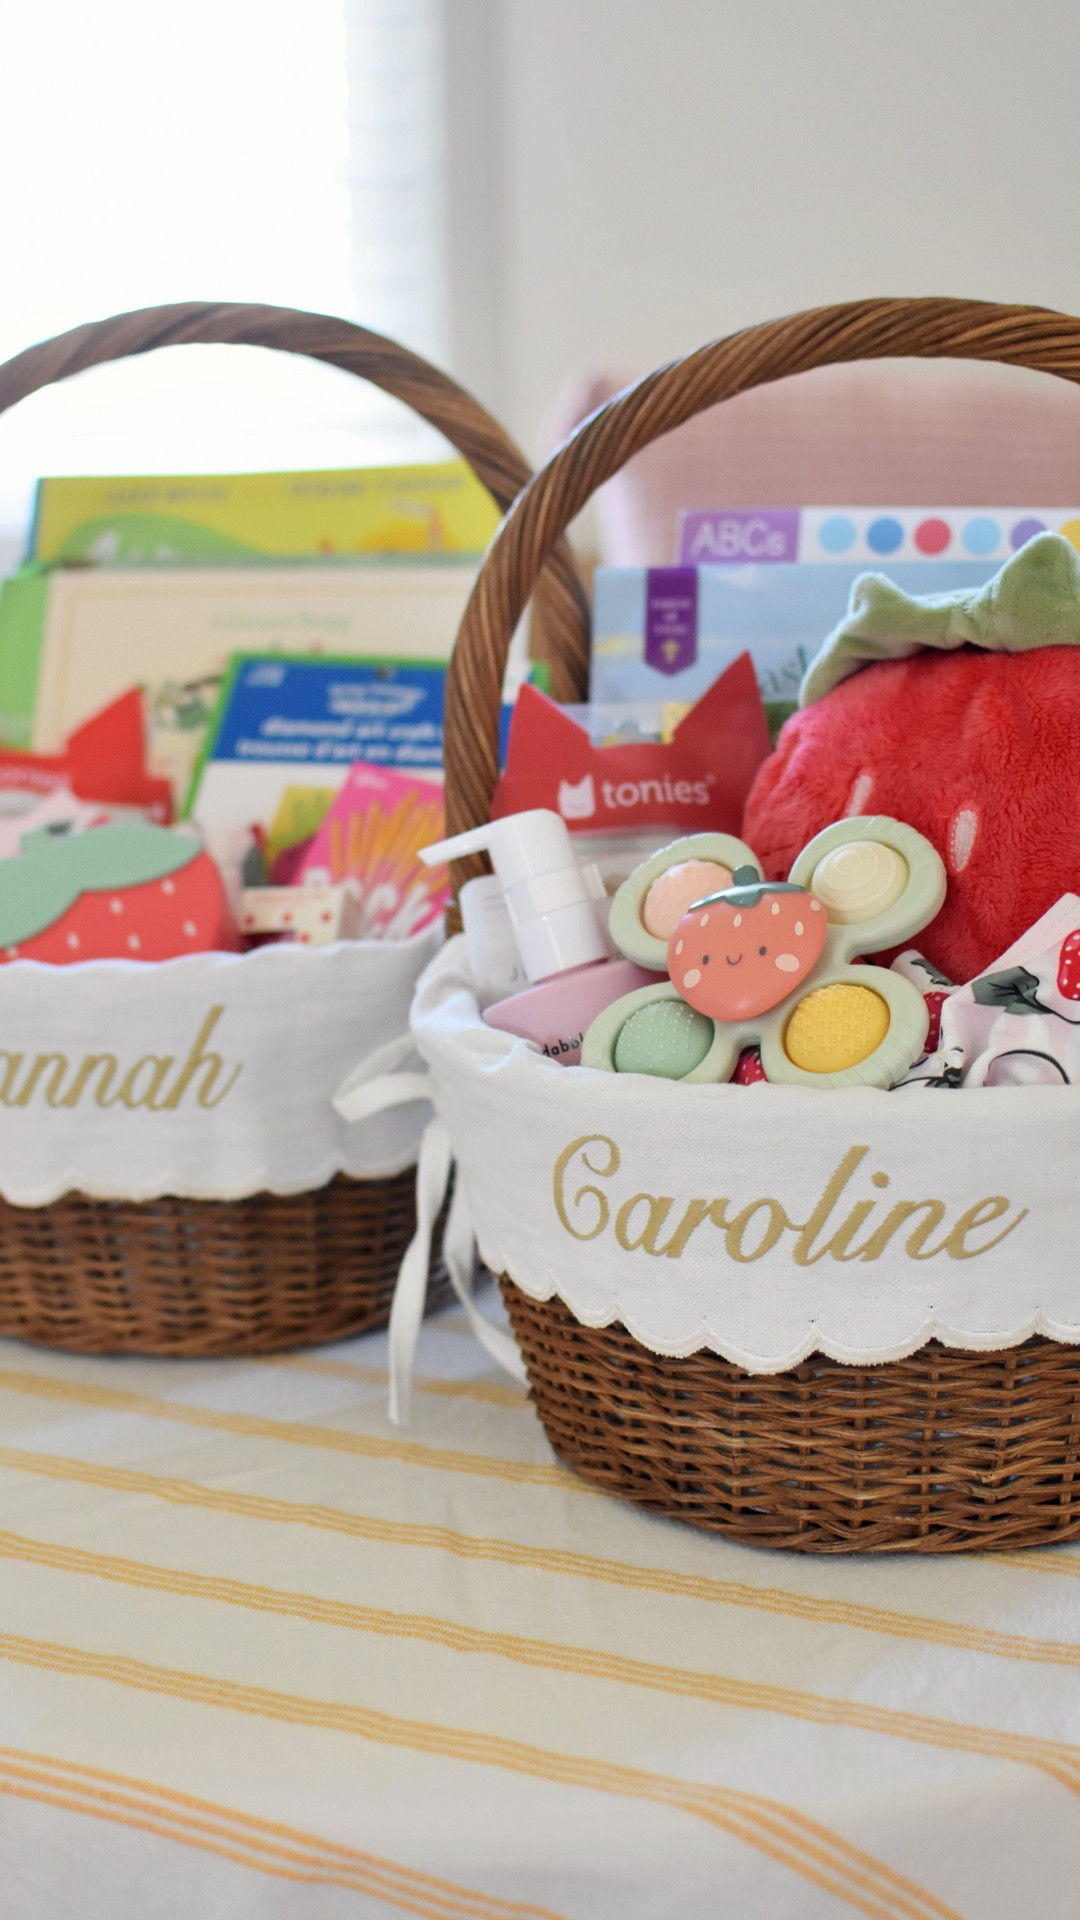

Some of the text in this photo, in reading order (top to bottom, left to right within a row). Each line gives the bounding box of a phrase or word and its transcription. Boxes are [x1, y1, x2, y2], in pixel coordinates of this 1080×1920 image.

[689, 518, 787, 558] ABCs
[602, 774, 710, 809] tonies
[553, 1134, 1029, 1266] Caroline
